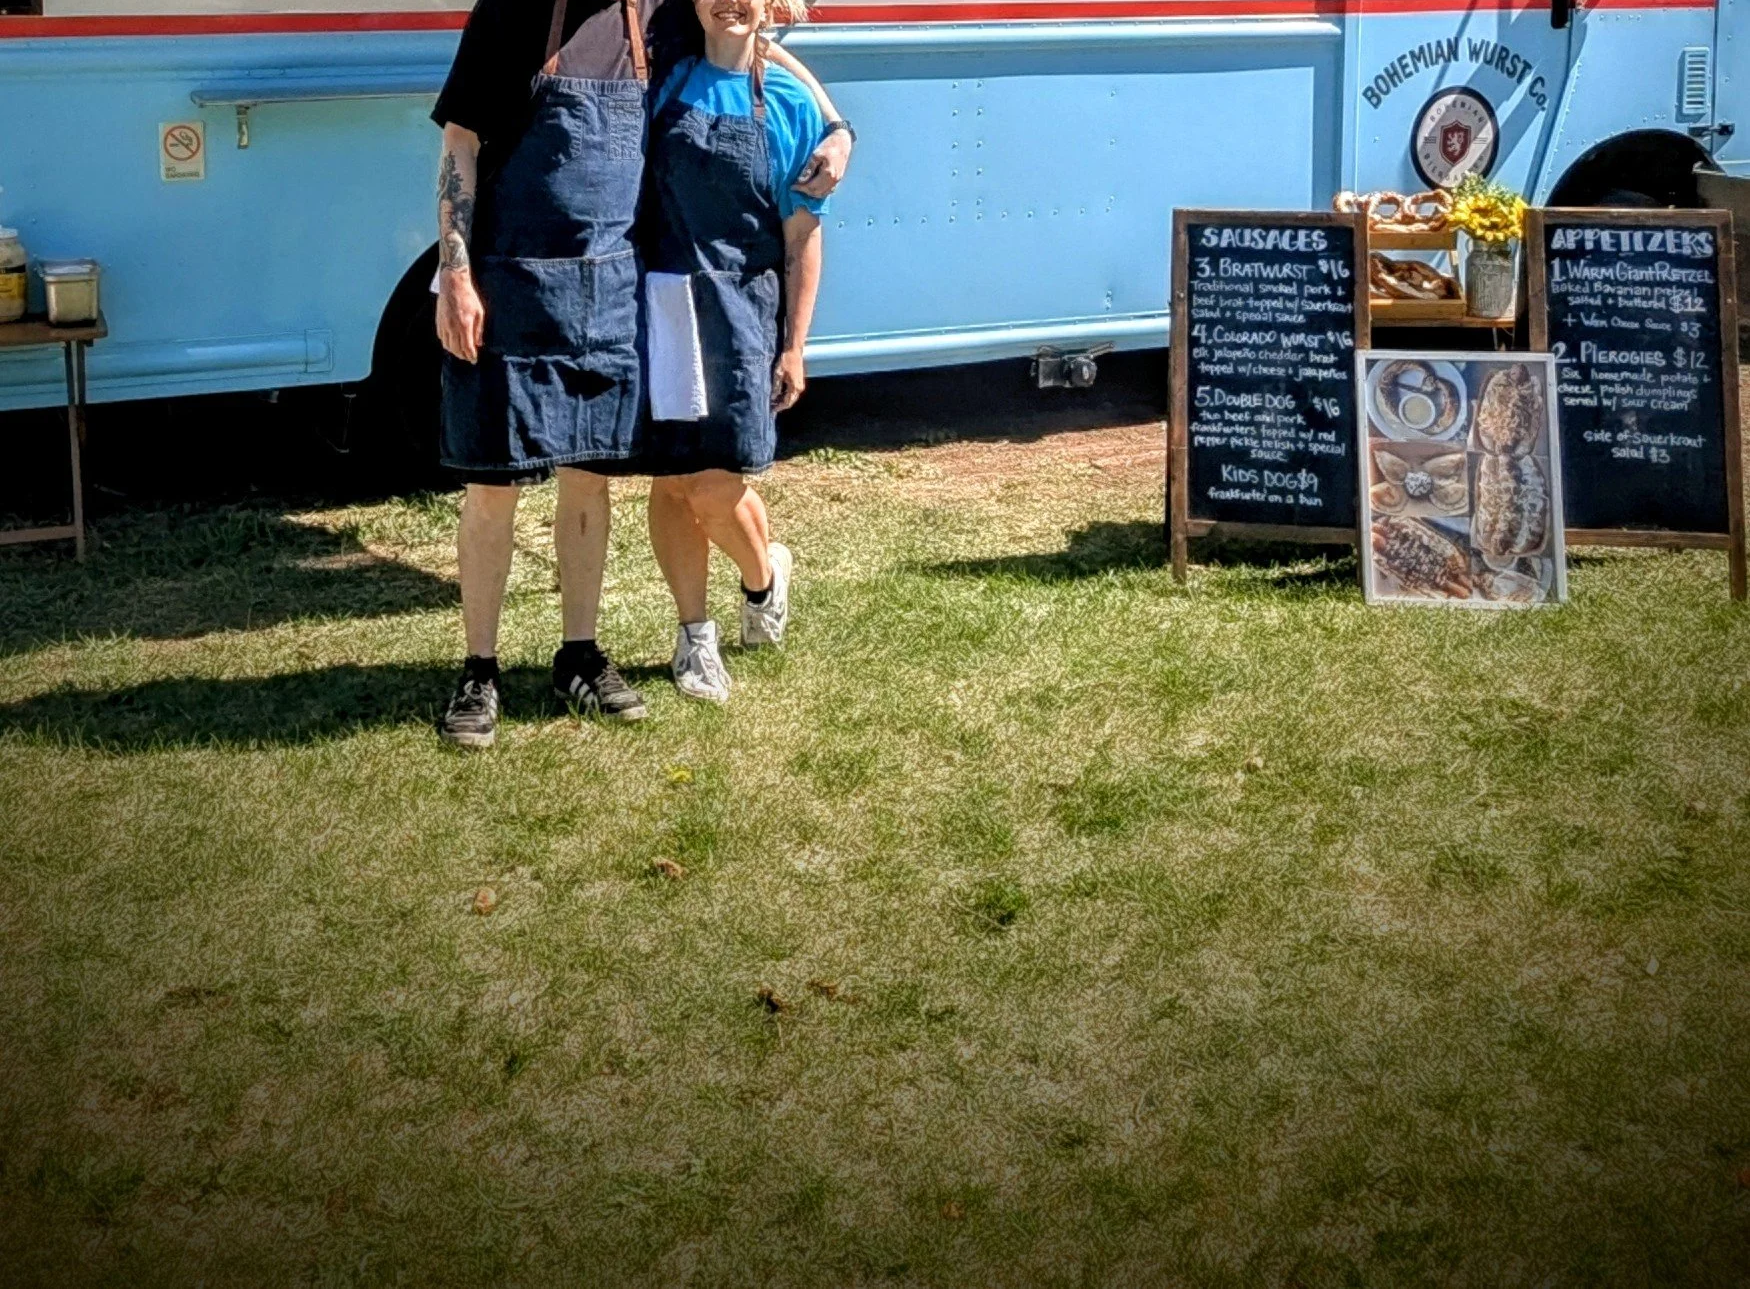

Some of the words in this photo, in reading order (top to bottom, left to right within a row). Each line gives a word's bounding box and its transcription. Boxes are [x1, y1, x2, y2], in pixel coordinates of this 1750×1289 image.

[1362, 37, 1459, 110] BOHEMIAN
[1467, 37, 1532, 85] WURST
[1201, 227, 1328, 252] SAUSAGES
[1550, 228, 1714, 258] APPETIZERS
[1194, 257, 1215, 278] 3.
[1219, 257, 1316, 280] BRATWURST
[1318, 258, 1350, 280] $16
[1566, 260, 1614, 280] WARM
[1616, 261, 1654, 281] Giant
[1654, 261, 1715, 284] PRETZEL
[1190, 280, 1253, 293] Traditional
[1259, 281, 1298, 294] smoked
[1304, 284, 1332, 297] pork
[1593, 282, 1653, 296] Bavarian
[1654, 285, 1698, 299] pretzel
[1192, 294, 1215, 307] beef
[1219, 295, 1245, 308] brat
[1247, 296, 1284, 311] topped
[1285, 297, 1299, 312] w/
[1567, 296, 1601, 306] salted
[1618, 297, 1666, 309] buttered
[1669, 295, 1707, 313] $12
[1563, 313, 1577, 327] +
[1645, 318, 1672, 331] Sauce
[1680, 322, 1701, 339] $3
[1191, 324, 1213, 345] 4.
[1213, 325, 1277, 344] COLORADO
[1280, 333, 1326, 348] WURST
[1326, 329, 1353, 349] $16
[1192, 347, 1209, 359] elk
[1258, 349, 1305, 361] cheddar
[1309, 351, 1338, 364] brat
[1552, 341, 1577, 363] 2.
[1580, 341, 1666, 366] PIEROGIES
[1673, 347, 1709, 369] $12
[1197, 362, 1234, 376] topped
[1237, 362, 1251, 377] w/
[1591, 368, 1656, 383] homemade
[1660, 371, 1699, 386] potato
[1194, 384, 1214, 408] 5.
[1214, 388, 1262, 408] DOUBLE
[1265, 394, 1295, 409] DOG
[1312, 396, 1341, 418] $16
[1557, 383, 1595, 394] cheese
[1635, 385, 1697, 403] dumplings
[1563, 396, 1597, 407] served
[1602, 396, 1617, 411] w/
[1199, 410, 1221, 421] two
[1224, 411, 1250, 422] beef
[1253, 412, 1275, 424] and
[1277, 413, 1306, 427] pork
[1261, 425, 1295, 440] topped
[1299, 429, 1314, 442] w/
[1318, 431, 1336, 442] red
[1617, 430, 1632, 442] of
[1193, 436, 1227, 447] pepper
[1230, 437, 1260, 448] pickle
[1262, 439, 1295, 451] relish
[1308, 442, 1345, 456] special
[1650, 446, 1670, 463] $3
[1250, 450, 1289, 462] sauce
[1264, 470, 1298, 489] DOG
[1297, 468, 1318, 493] $9
[1268, 494, 1283, 504] on
[1285, 495, 1294, 504] a
[1299, 493, 1323, 507] bun
